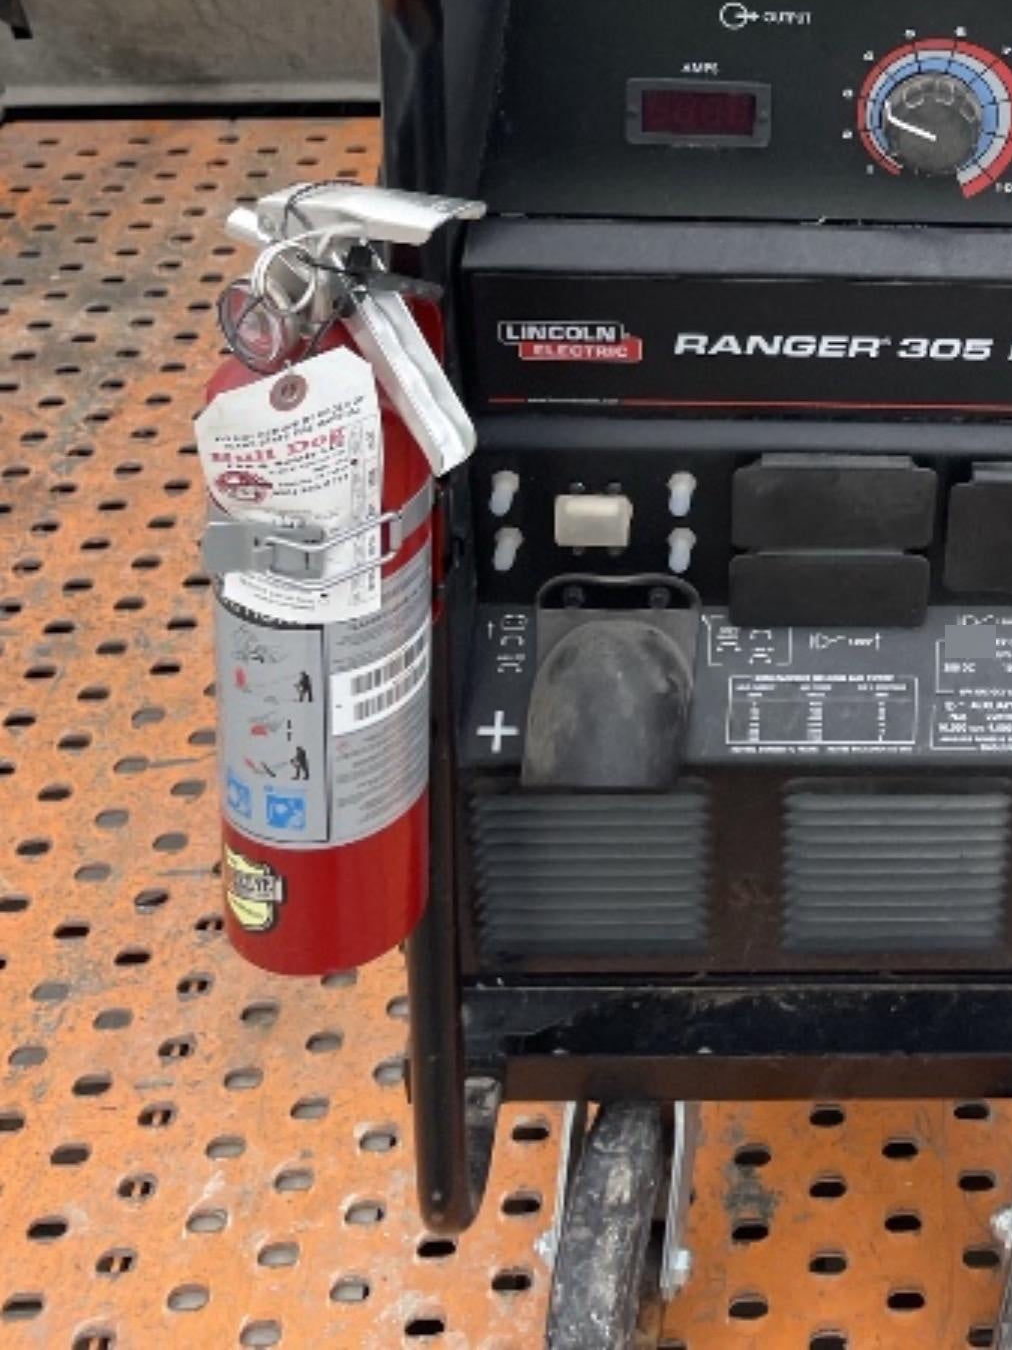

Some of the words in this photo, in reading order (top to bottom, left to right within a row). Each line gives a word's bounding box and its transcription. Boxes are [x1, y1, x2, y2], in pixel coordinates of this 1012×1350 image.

[505, 325, 616, 342] LINCOLN
[532, 343, 629, 359] ELECTRIC
[674, 333, 880, 358] RANGER
[897, 338, 993, 361] 305
